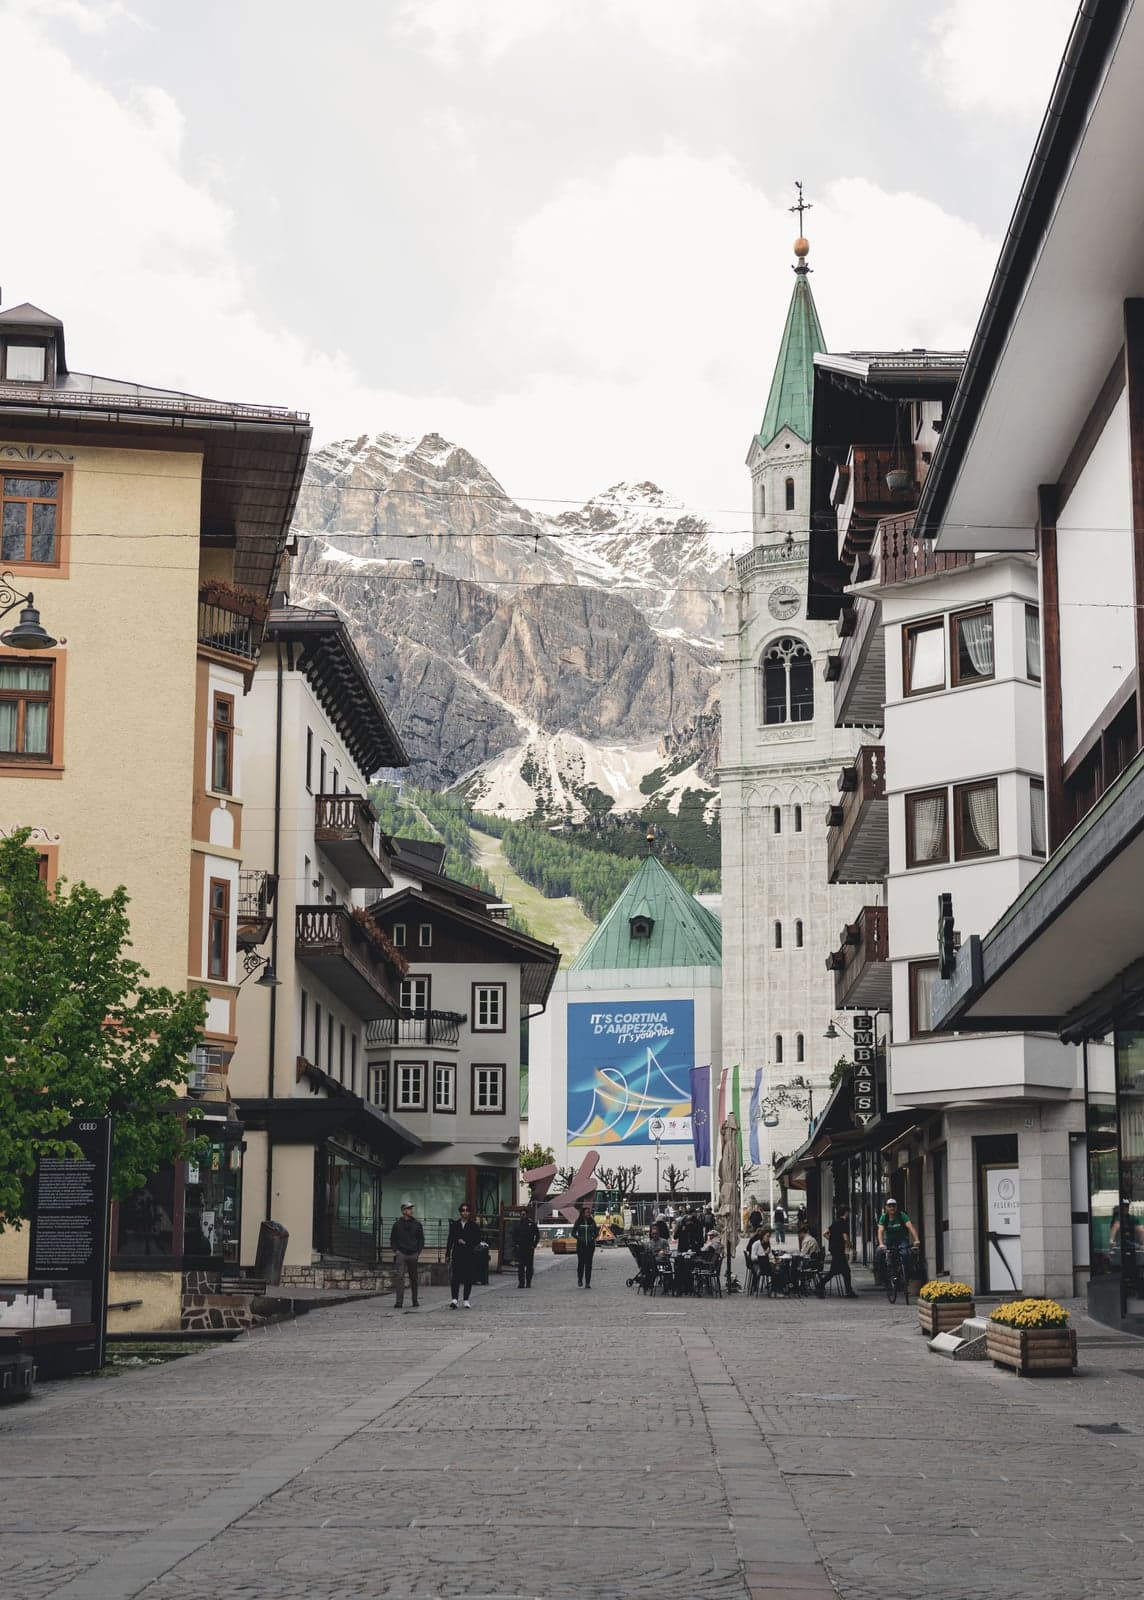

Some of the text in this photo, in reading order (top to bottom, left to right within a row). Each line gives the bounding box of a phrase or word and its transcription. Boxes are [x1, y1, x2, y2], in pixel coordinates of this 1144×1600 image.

[590, 1012, 668, 1024] IT'S CORTINA
[633, 1030, 657, 1043] your
[657, 1026, 675, 1037] vibe
[856, 1017, 872, 1125] EMBASSY
